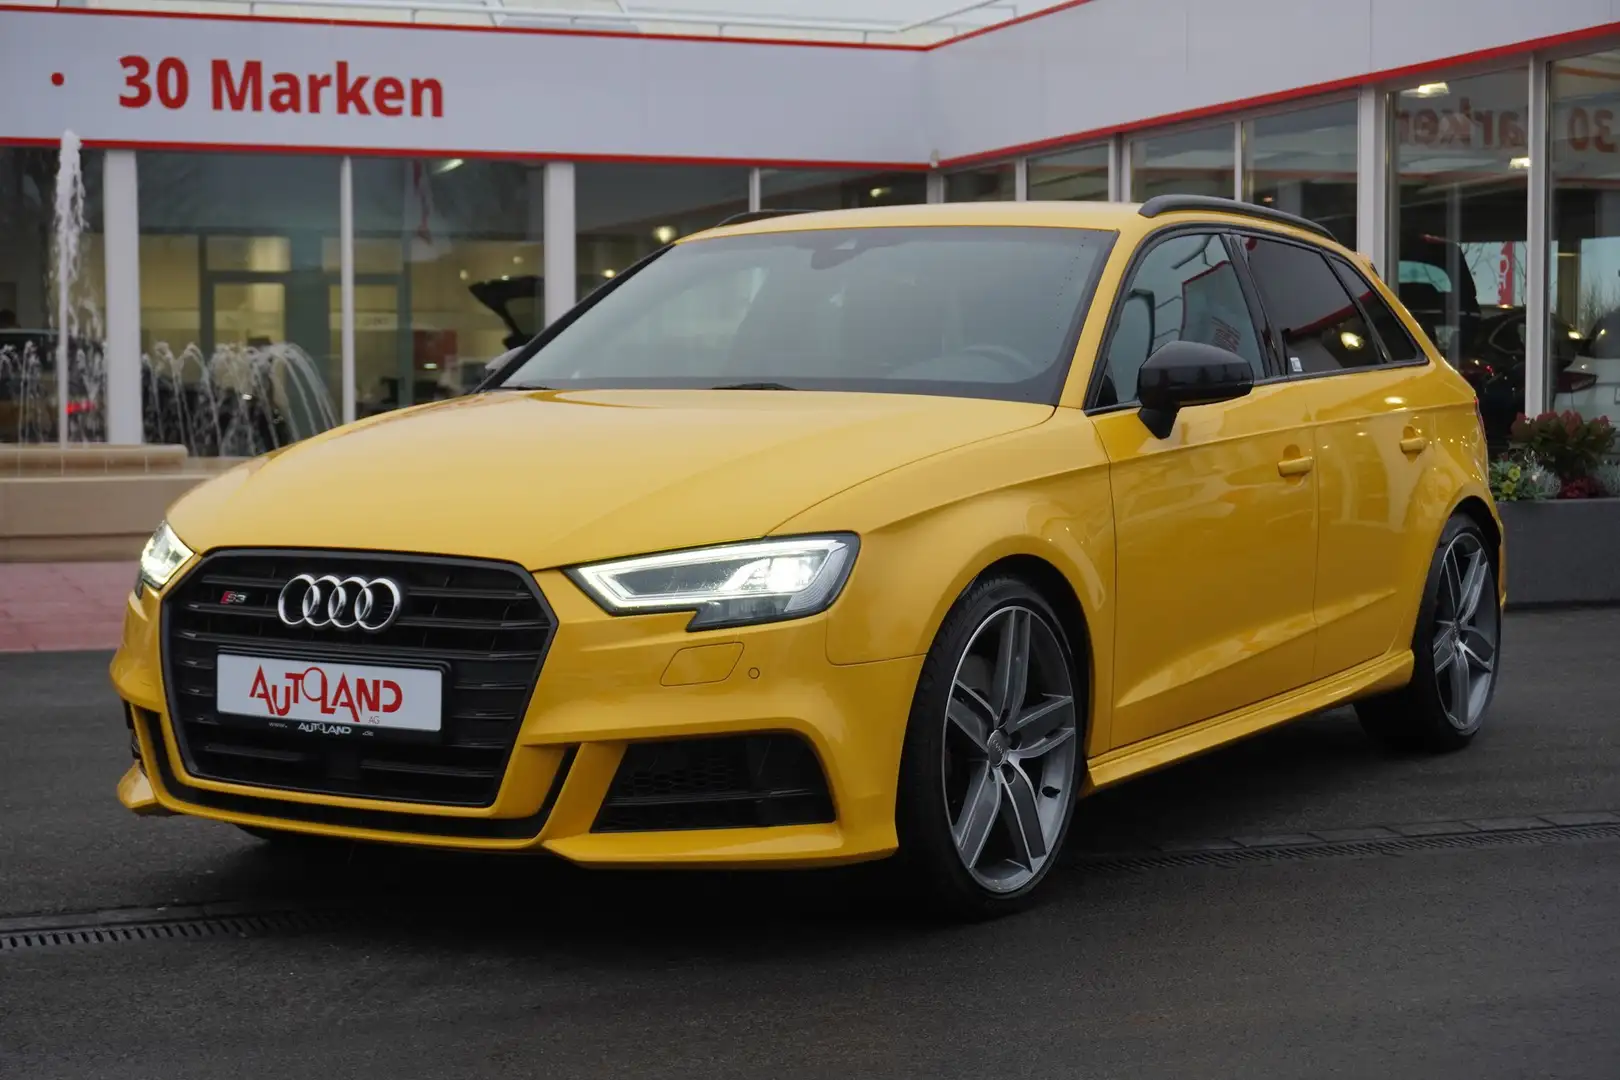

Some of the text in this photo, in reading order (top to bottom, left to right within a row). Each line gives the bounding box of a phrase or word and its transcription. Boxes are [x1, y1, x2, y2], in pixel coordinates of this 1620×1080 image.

[119, 55, 444, 118] 30 Marken
[249, 665, 403, 722] AUTOLAND
[298, 722, 352, 735] AUTOLAND
[368, 716, 380, 725] AG
